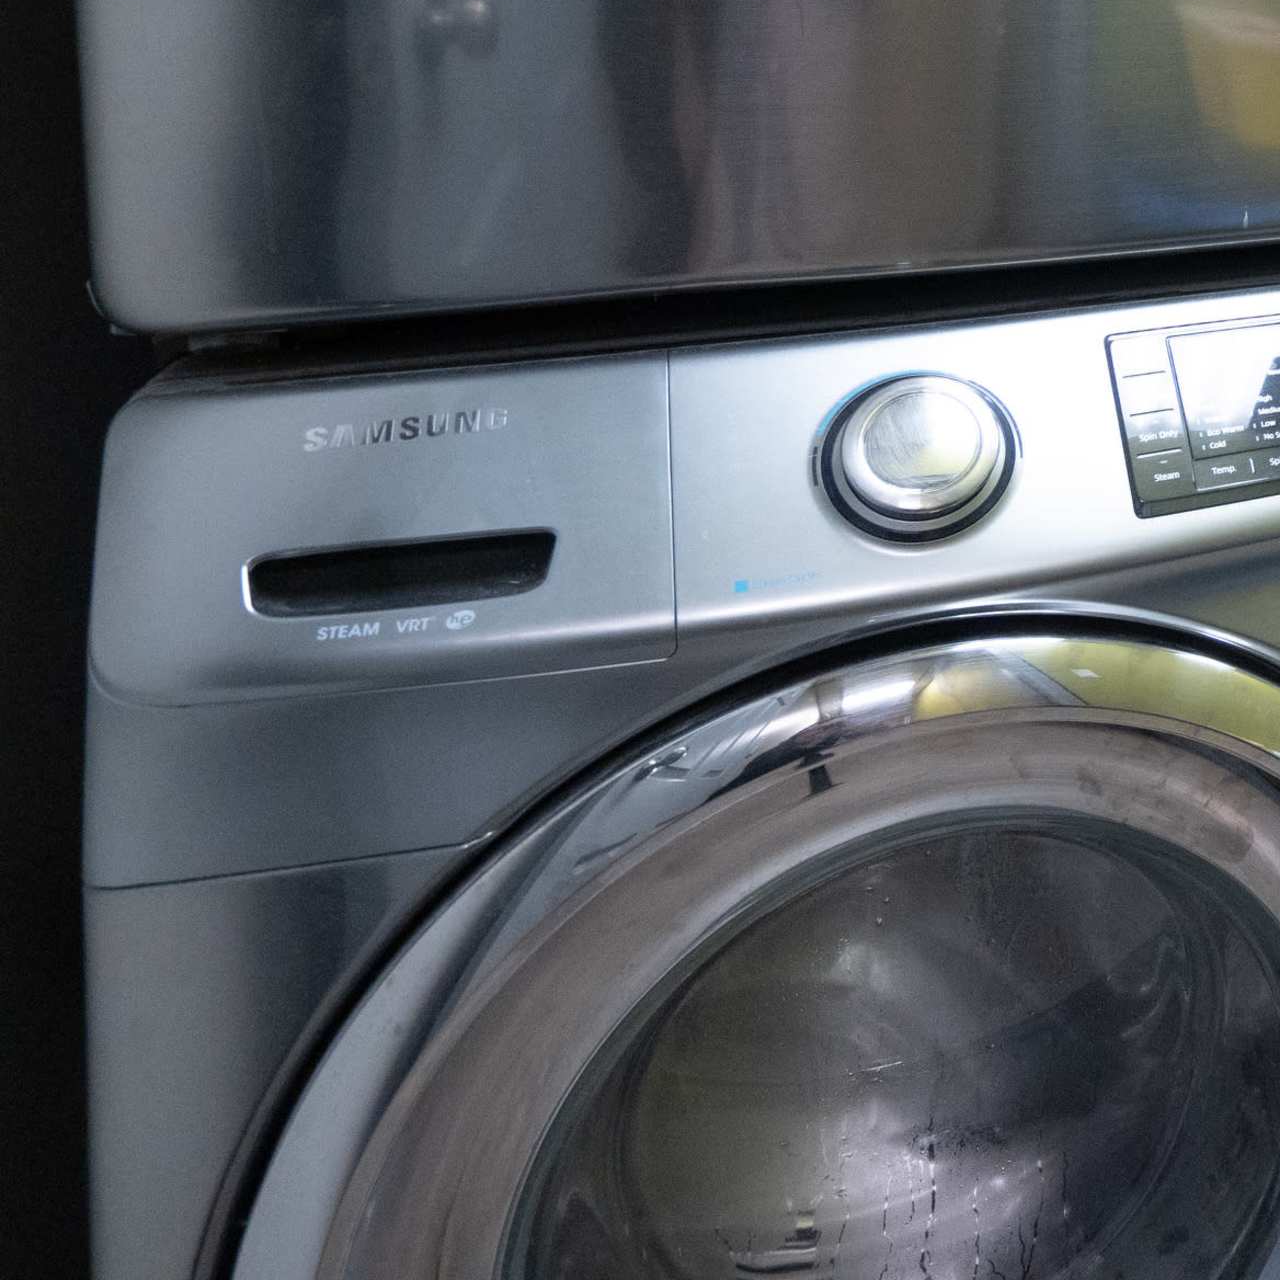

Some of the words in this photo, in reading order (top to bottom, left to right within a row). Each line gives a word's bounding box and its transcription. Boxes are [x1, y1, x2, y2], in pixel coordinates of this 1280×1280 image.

[1260, 419, 1277, 428] Low
[303, 409, 508, 452] SAMSUNG
[1139, 432, 1157, 443] Spin
[1158, 429, 1179, 441] Only
[1263, 432, 1274, 440] No
[1209, 440, 1226, 449] Cold
[1211, 464, 1237, 475] Temp.
[1153, 472, 1180, 482] Steam
[316, 622, 380, 640] STEAM
